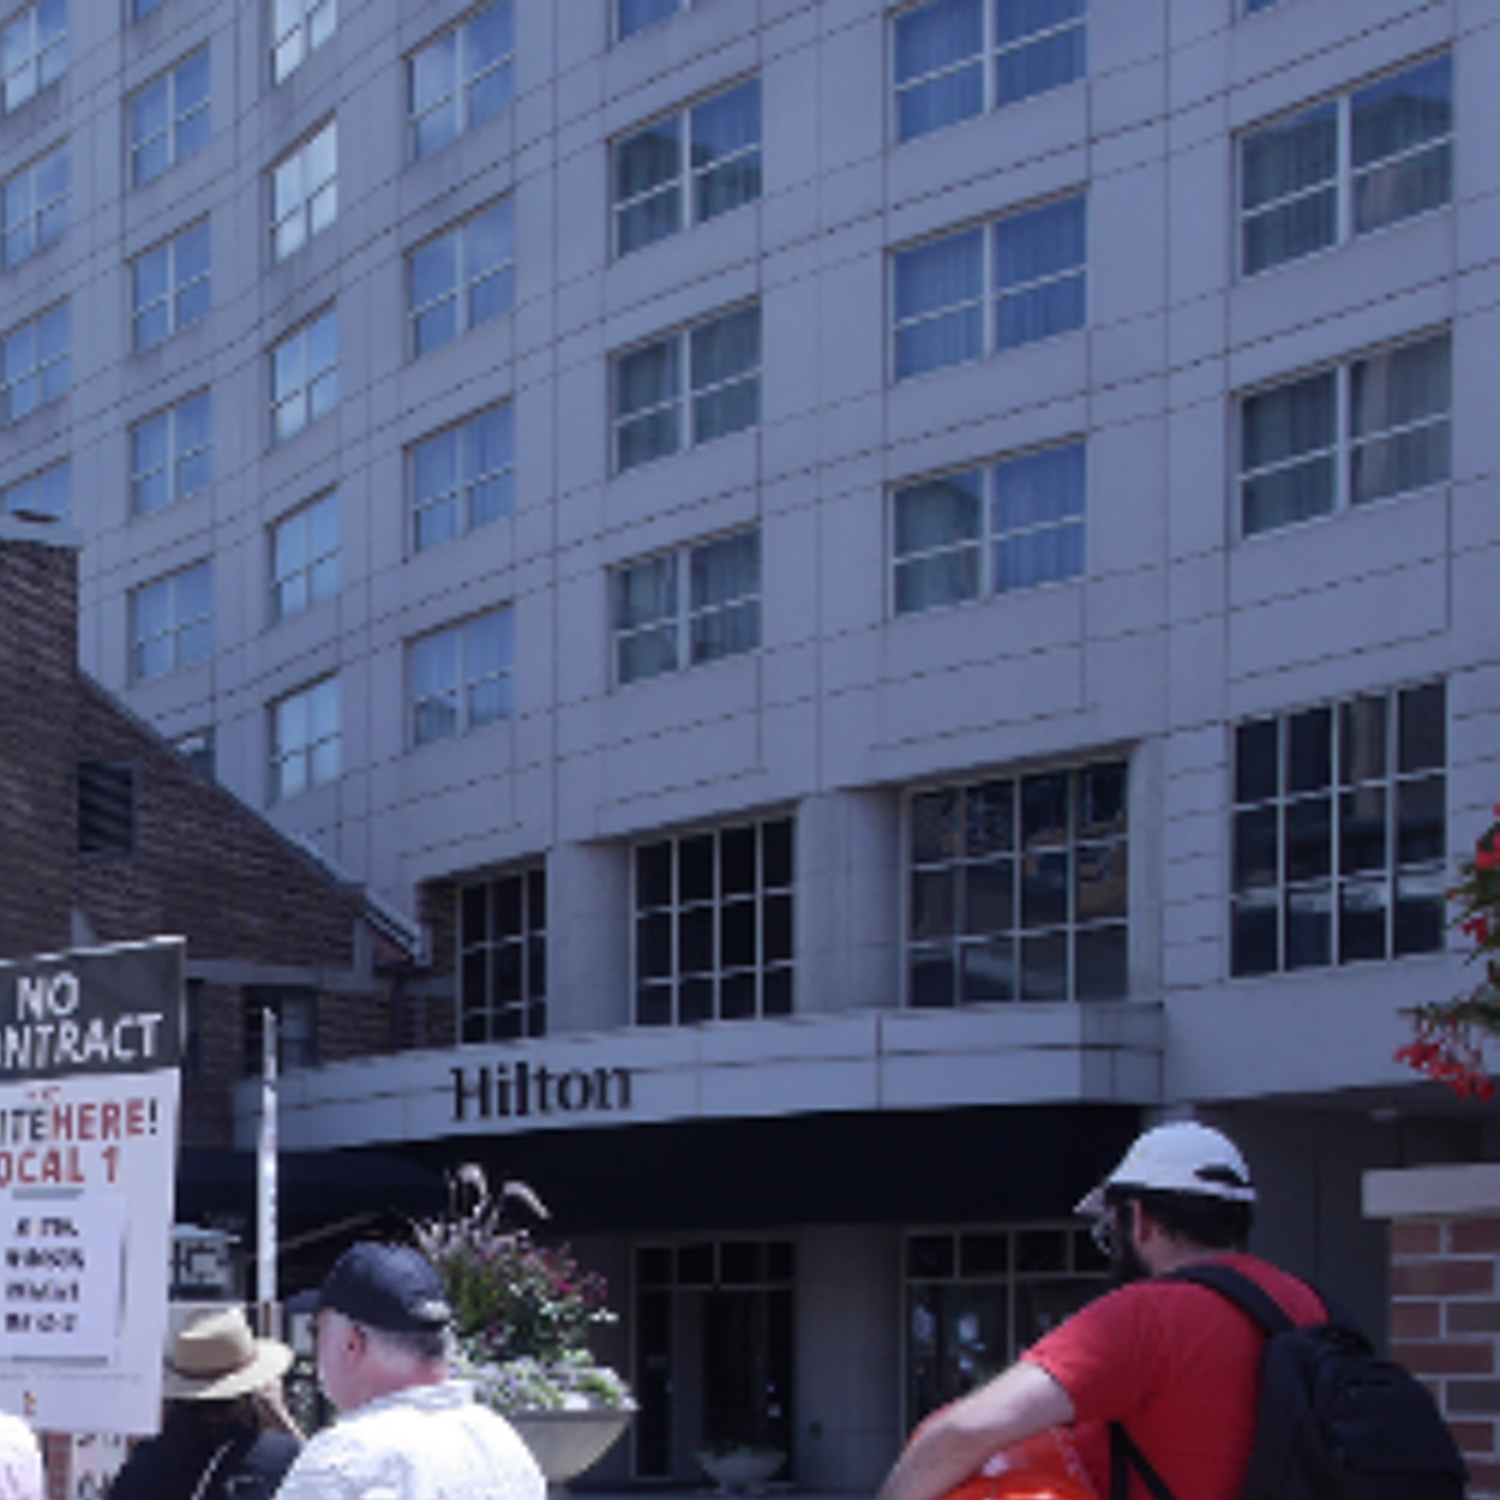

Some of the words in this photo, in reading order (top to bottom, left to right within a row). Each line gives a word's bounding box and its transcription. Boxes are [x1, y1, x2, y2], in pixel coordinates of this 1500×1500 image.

[16, 970, 80, 1021] NO
[450, 1061, 631, 1121] Hilton
[101, 1145, 120, 1184] 1
